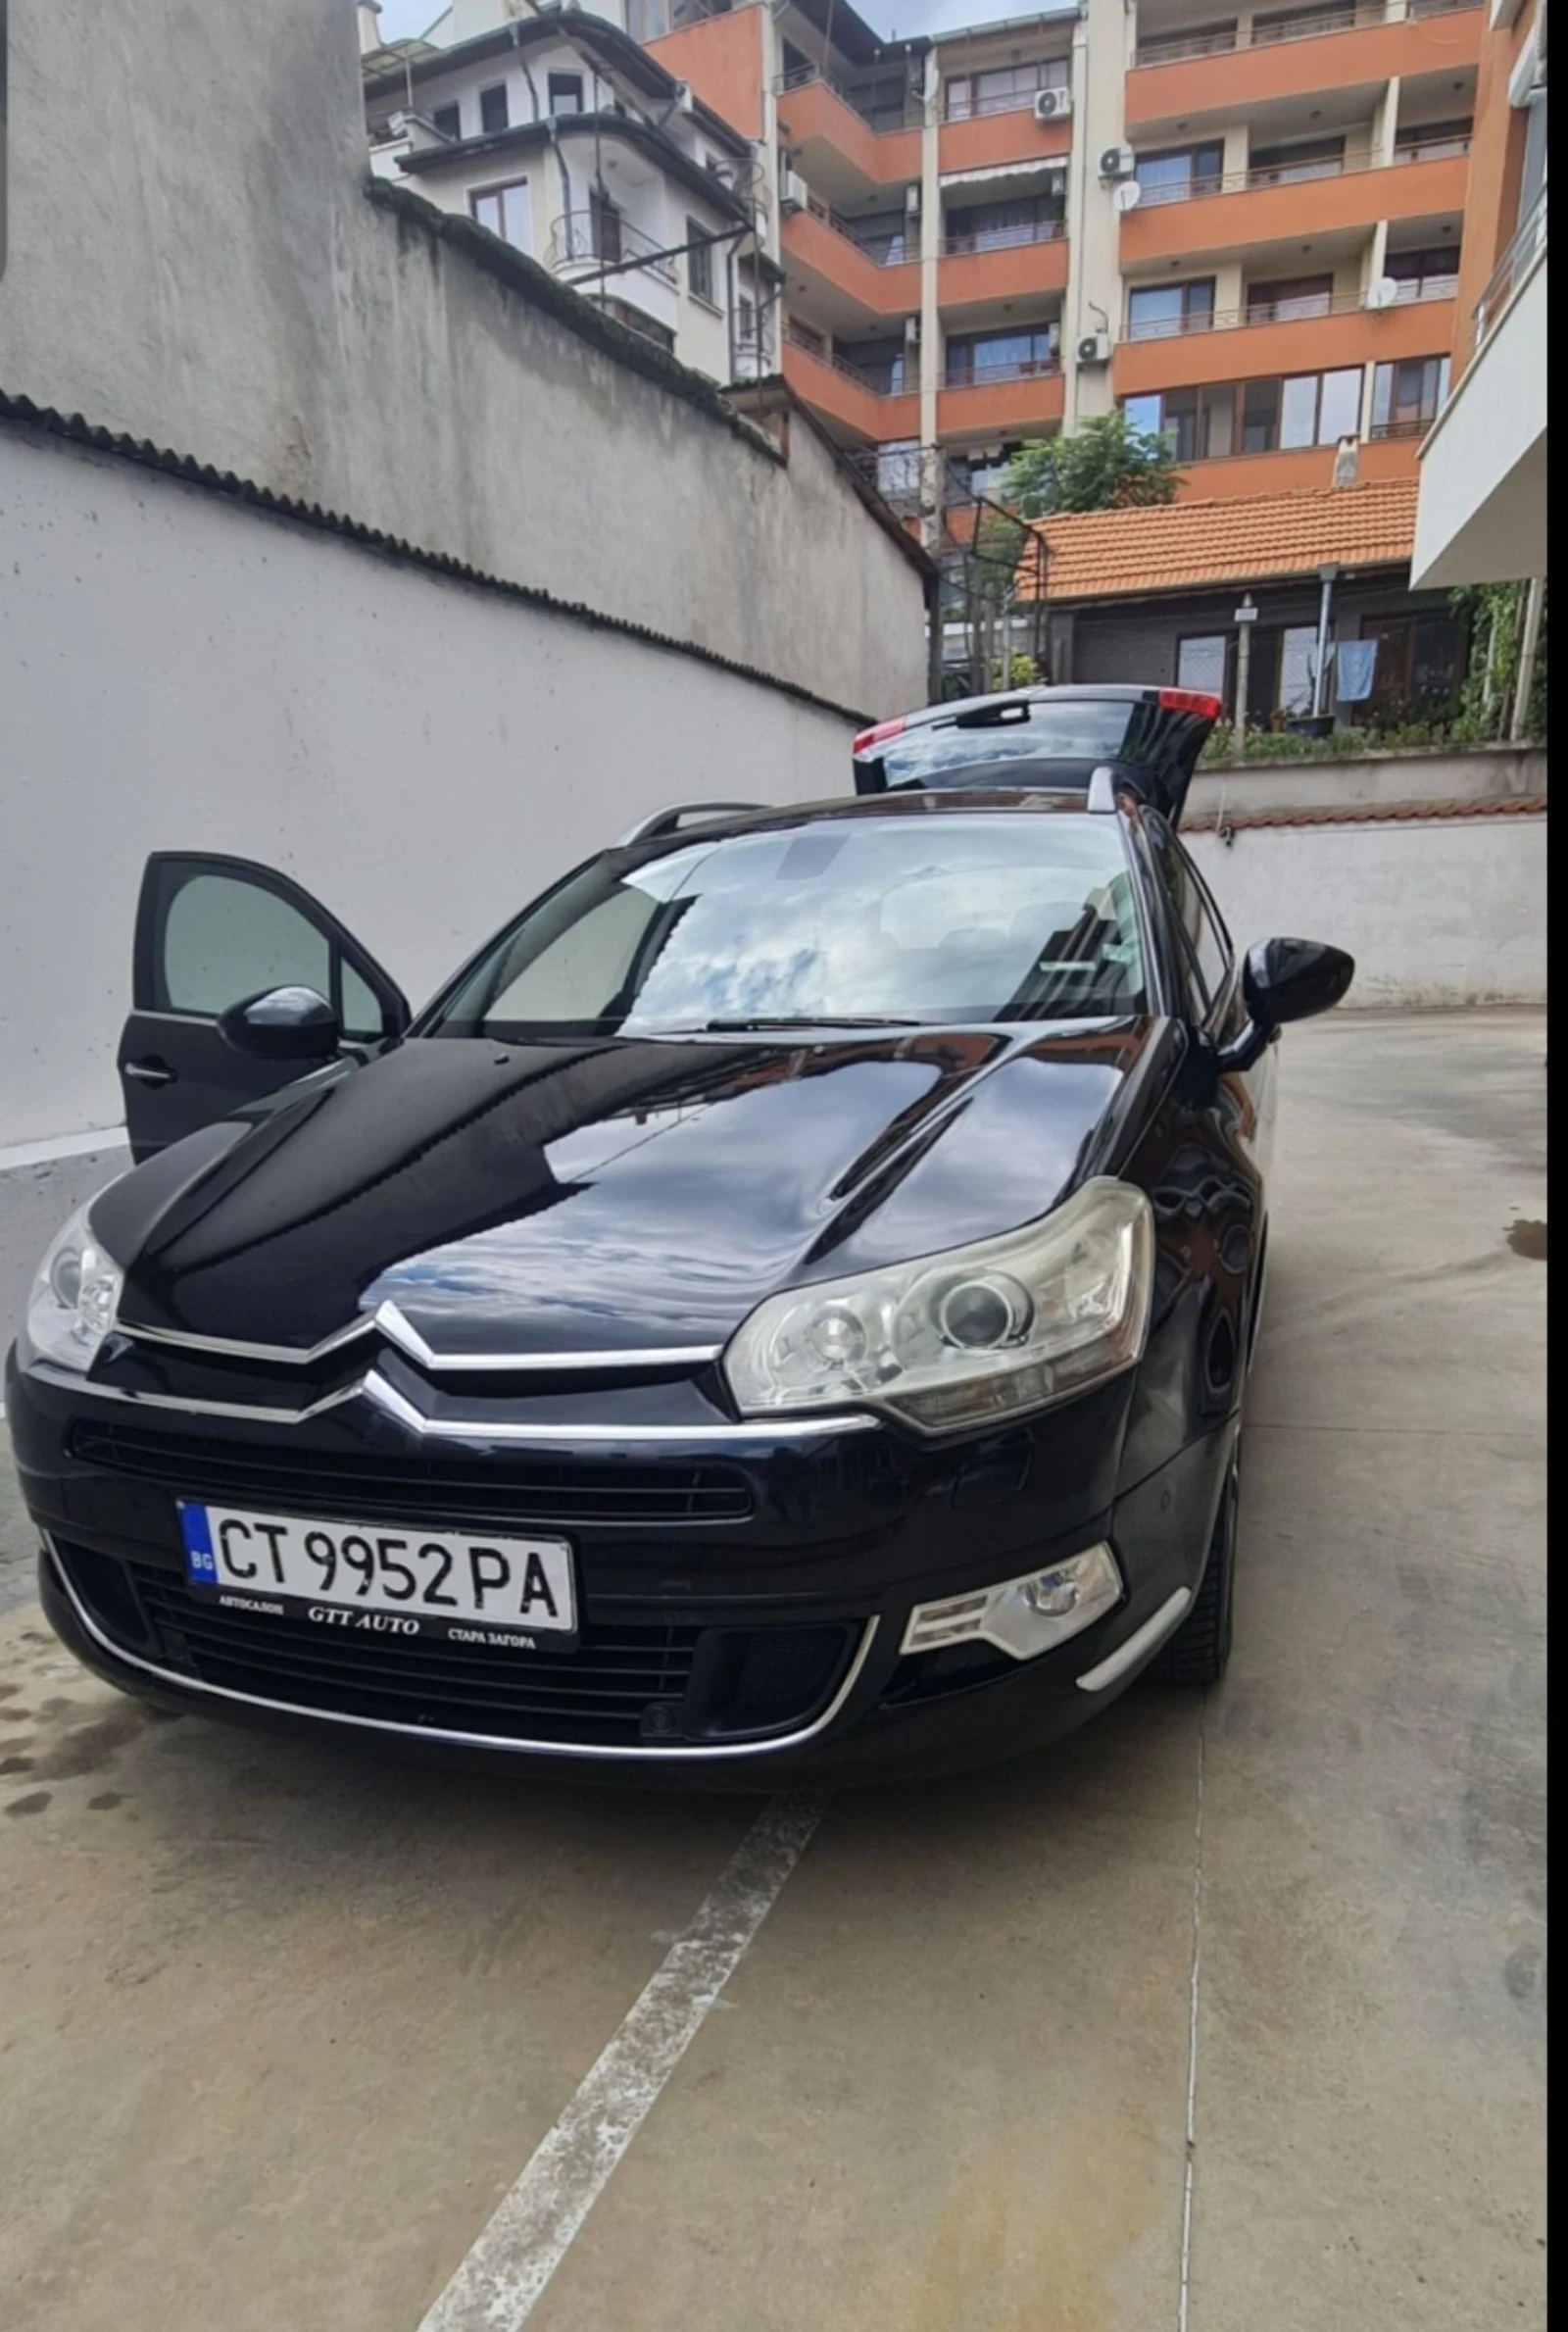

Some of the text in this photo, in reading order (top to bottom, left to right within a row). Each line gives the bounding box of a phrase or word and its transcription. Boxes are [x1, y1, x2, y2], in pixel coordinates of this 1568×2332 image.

[191, 1551, 213, 1570] BG
[218, 1518, 560, 1617] CT 9952 PA
[308, 1606, 420, 1635] GTT AUTO
[448, 1627, 536, 1649] СТАРА ЗАГОРА
